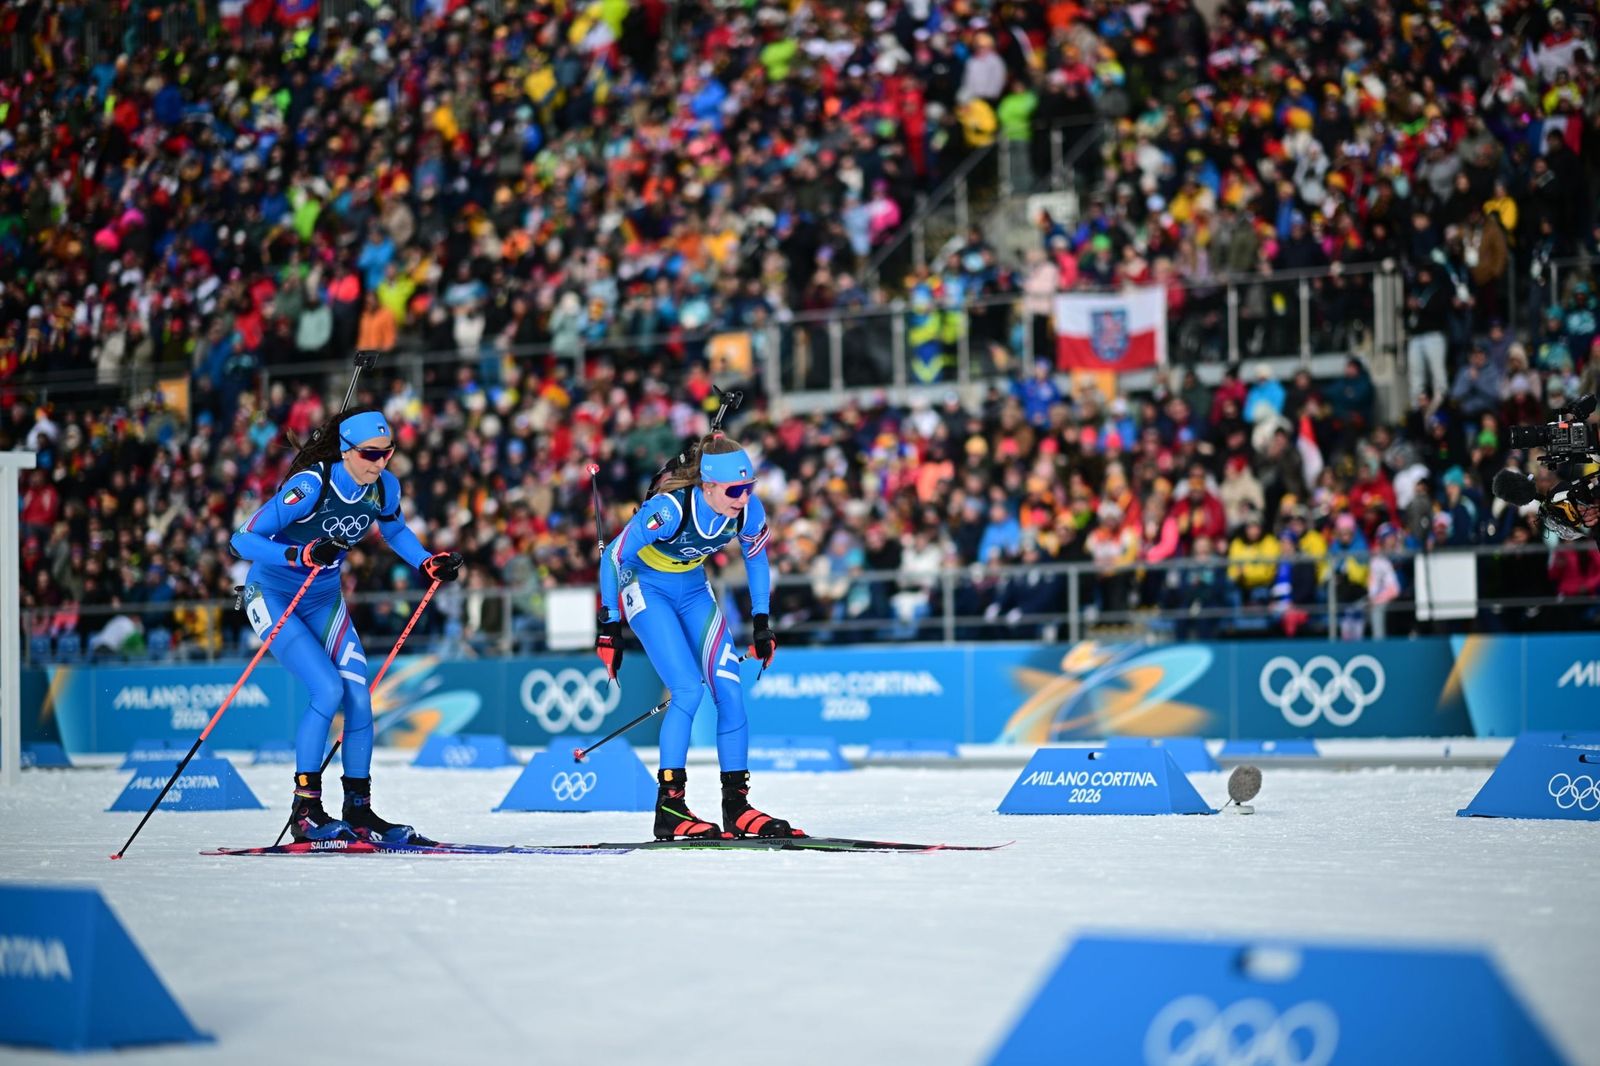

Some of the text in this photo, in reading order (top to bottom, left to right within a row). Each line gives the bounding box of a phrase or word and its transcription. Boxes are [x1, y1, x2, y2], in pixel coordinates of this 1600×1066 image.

[626, 593, 634, 607] 4
[252, 608, 261, 624] 4
[750, 671, 944, 698] MILANO CORTINA
[113, 685, 188, 710] MILANO
[820, 697, 870, 721] 2026
[177, 775, 219, 789] CORTINA
[1022, 771, 1158, 787] MILANO CORTINA
[1068, 788, 1102, 803] 2026
[310, 840, 348, 849] SALOMON
[0, 936, 73, 982] TINA
